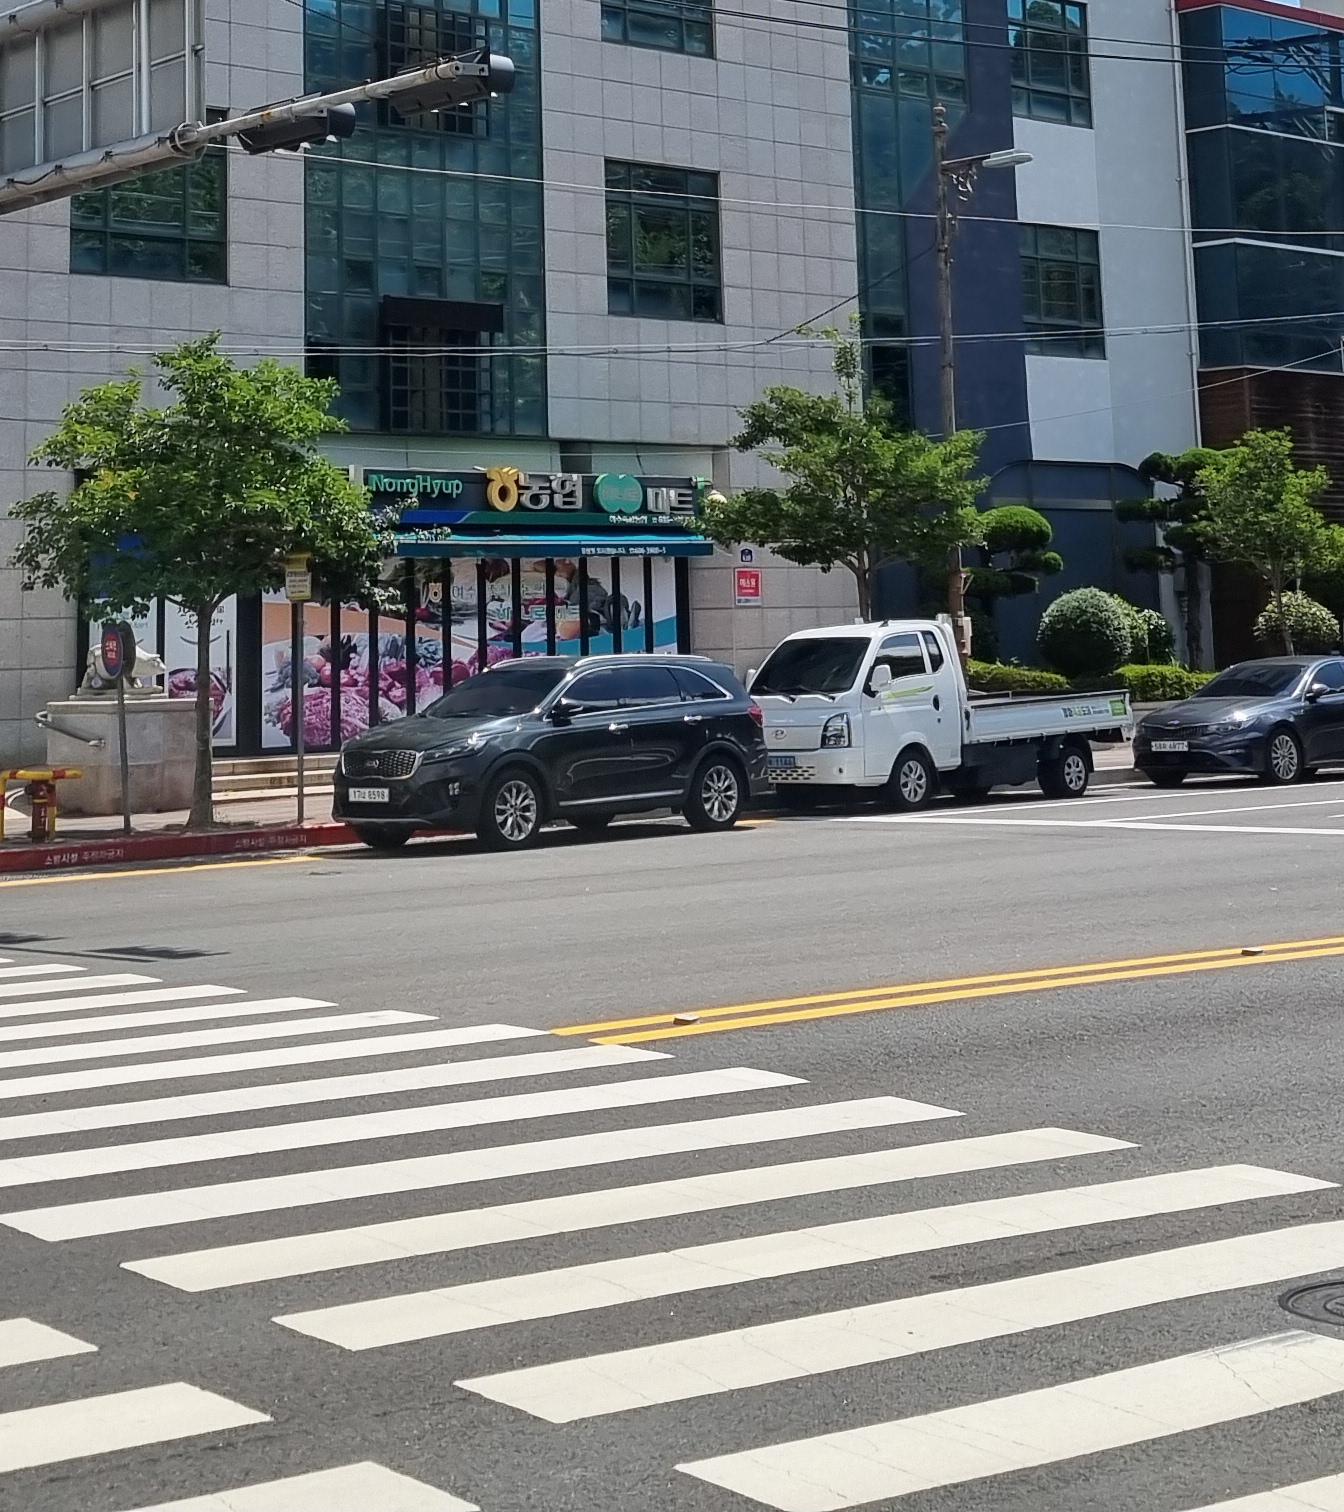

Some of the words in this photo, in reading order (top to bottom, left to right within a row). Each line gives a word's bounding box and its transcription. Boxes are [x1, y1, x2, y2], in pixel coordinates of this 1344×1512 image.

[368, 474, 463, 499] NongHyup
[518, 472, 583, 510] 농협
[646, 487, 696, 515] 마트
